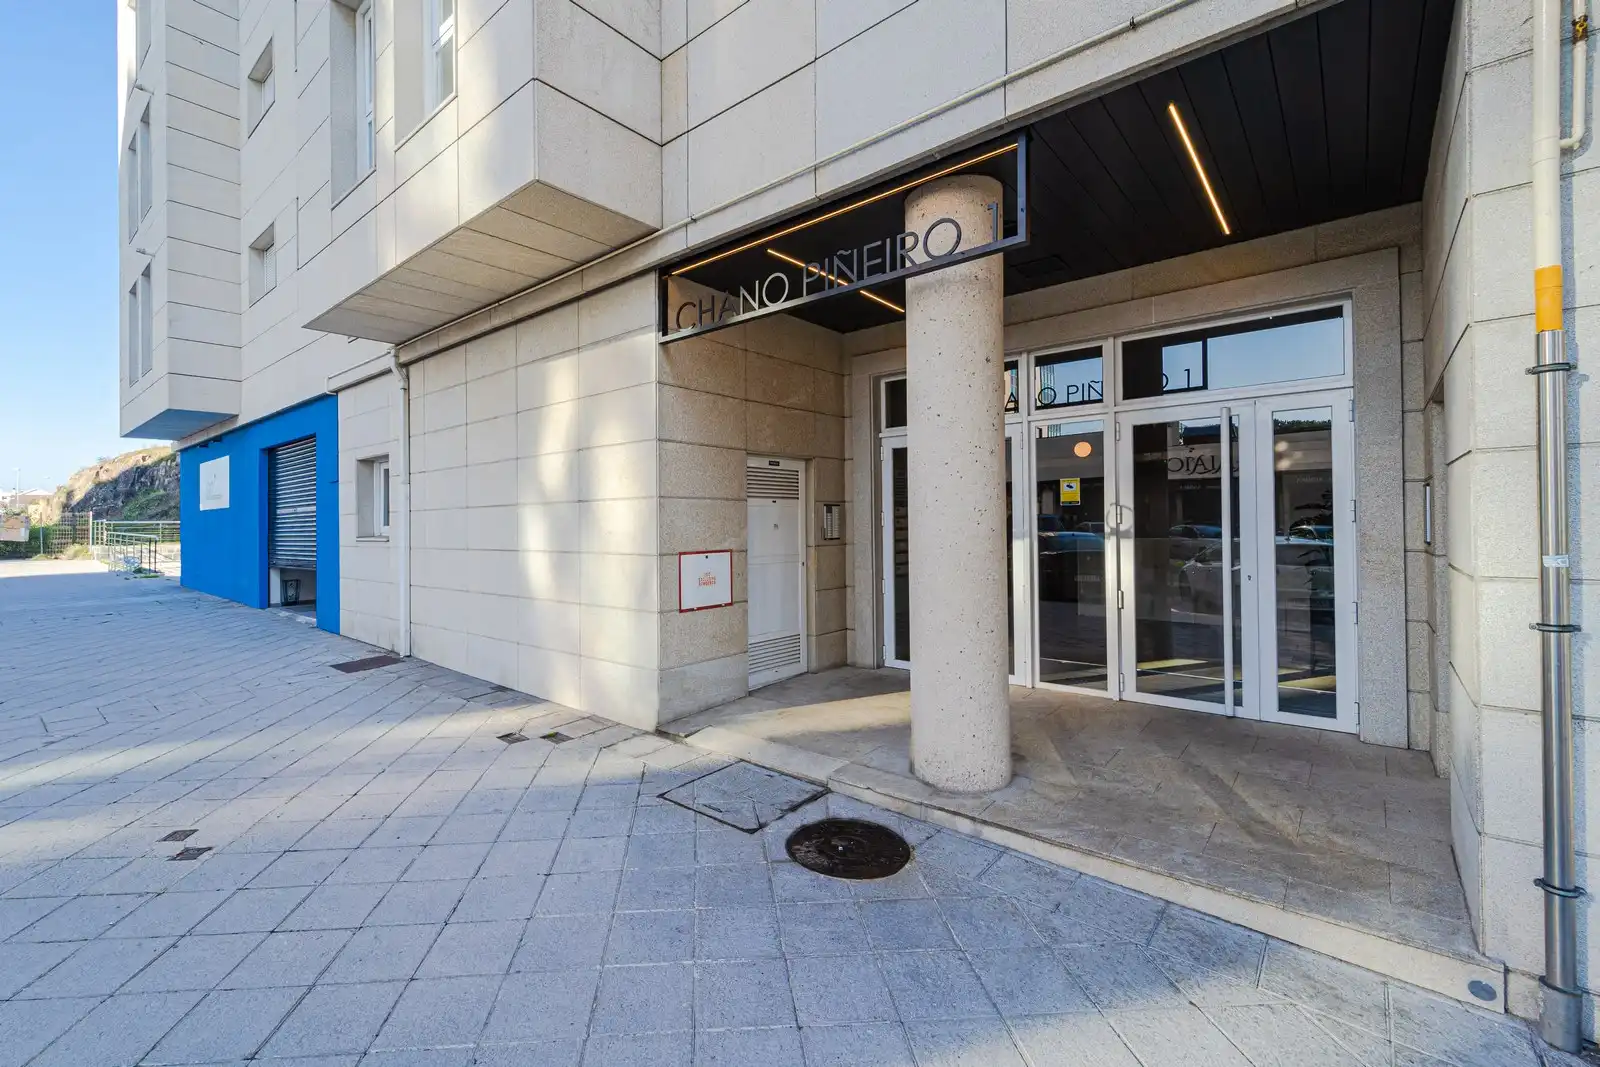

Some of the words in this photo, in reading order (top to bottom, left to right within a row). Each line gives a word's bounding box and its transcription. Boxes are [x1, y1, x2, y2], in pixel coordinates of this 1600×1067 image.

[676, 272, 789, 330] CHANO
[803, 217, 963, 298] PIÑEIRO
[988, 202, 998, 242] 1
